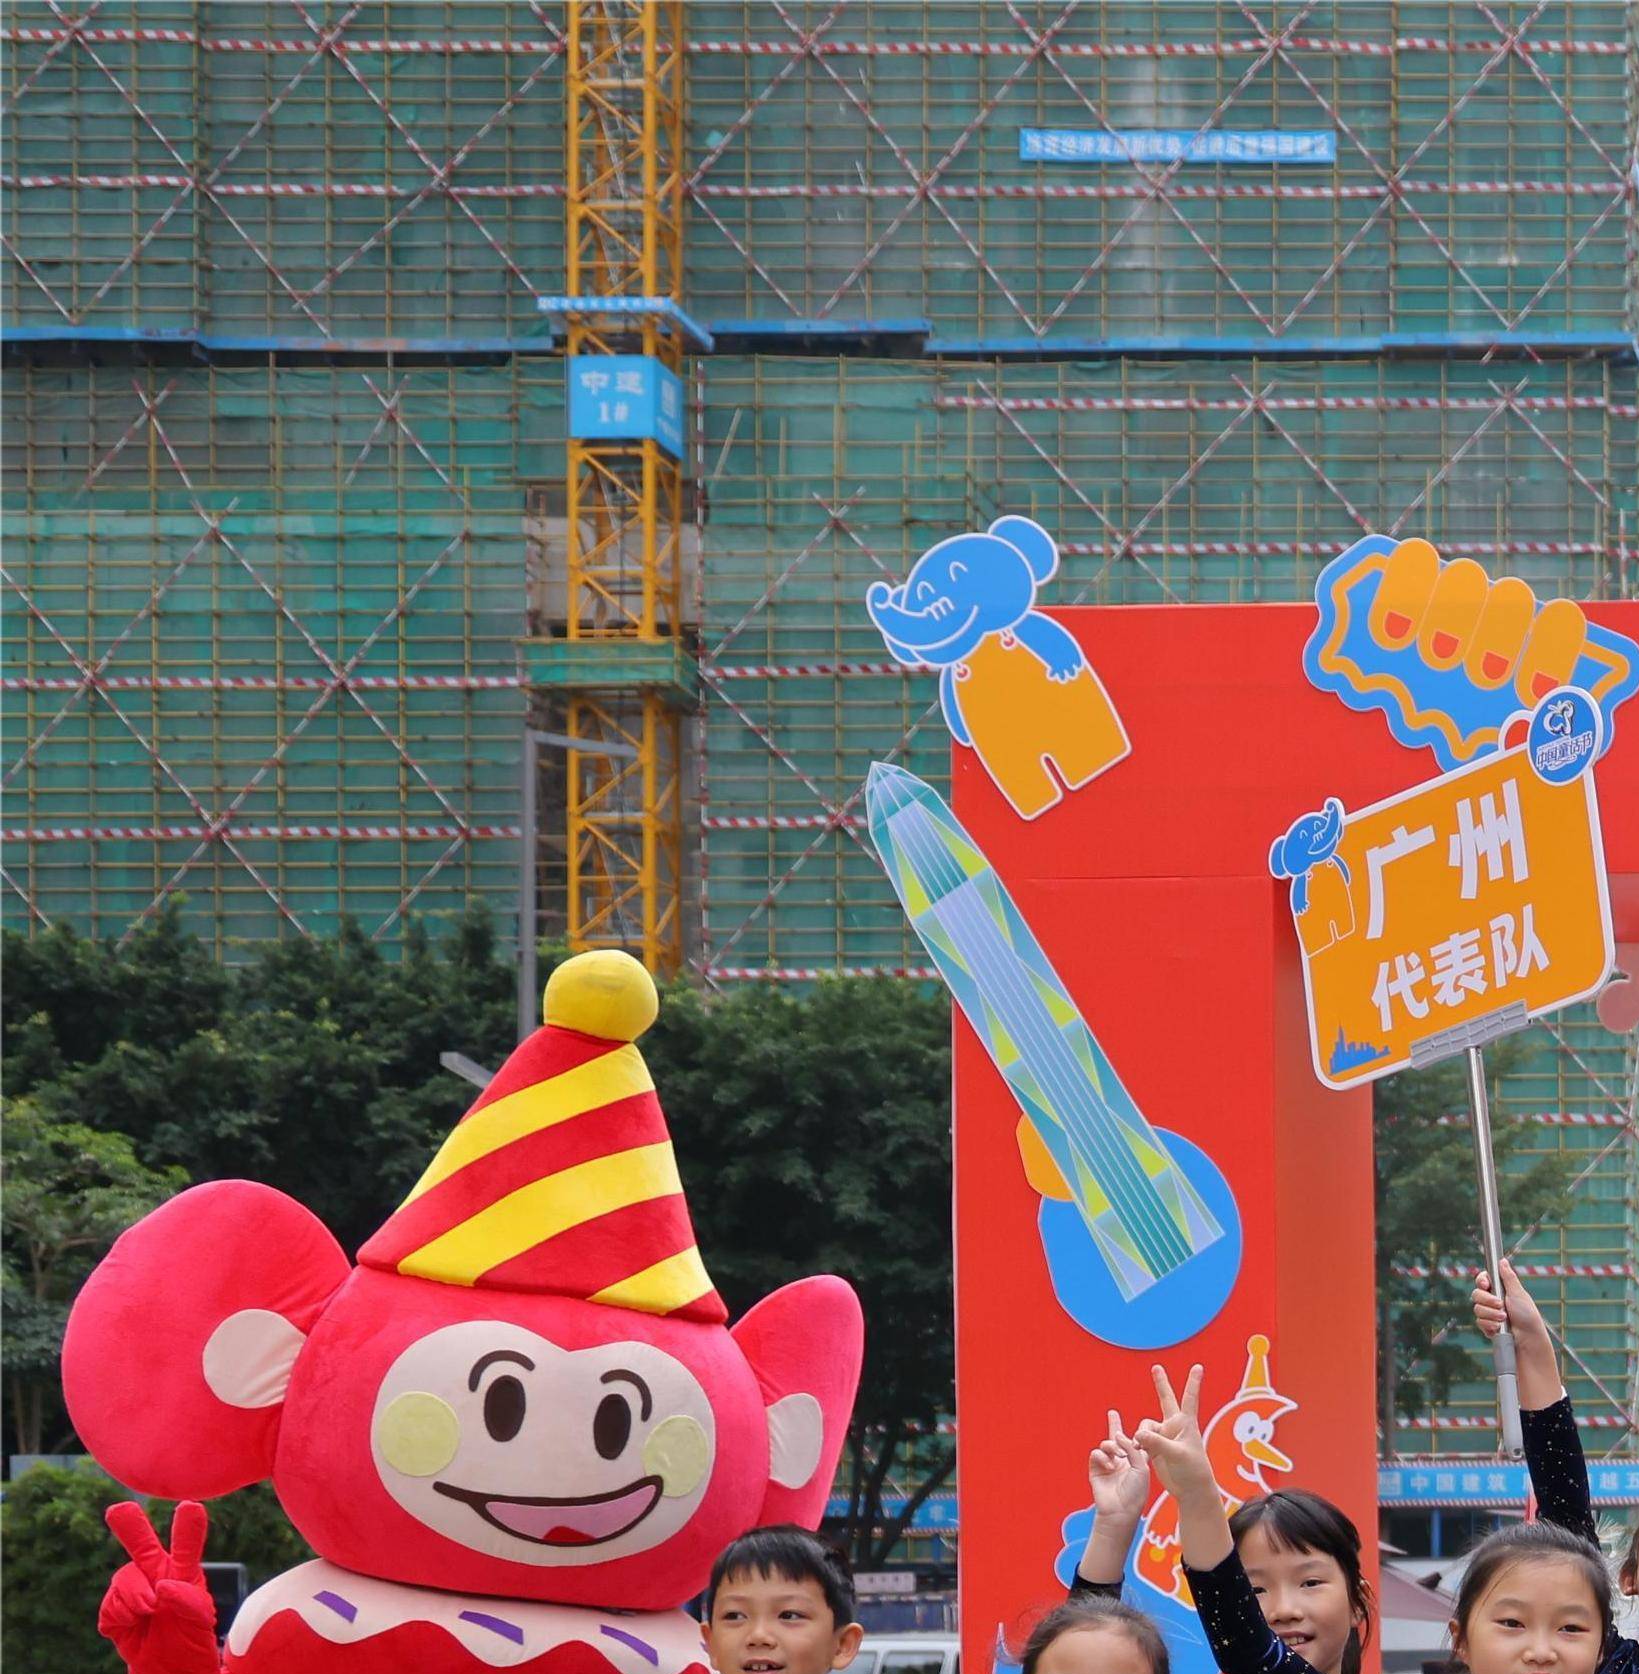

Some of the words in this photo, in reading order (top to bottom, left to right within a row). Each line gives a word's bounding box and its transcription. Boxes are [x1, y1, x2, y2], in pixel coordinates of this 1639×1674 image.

[1537, 733, 1592, 768] 中国童话节
[1366, 778, 1530, 940] 广州
[1371, 904, 1550, 1032] 代表队
[1410, 1473, 1506, 1492] 中国建筑
